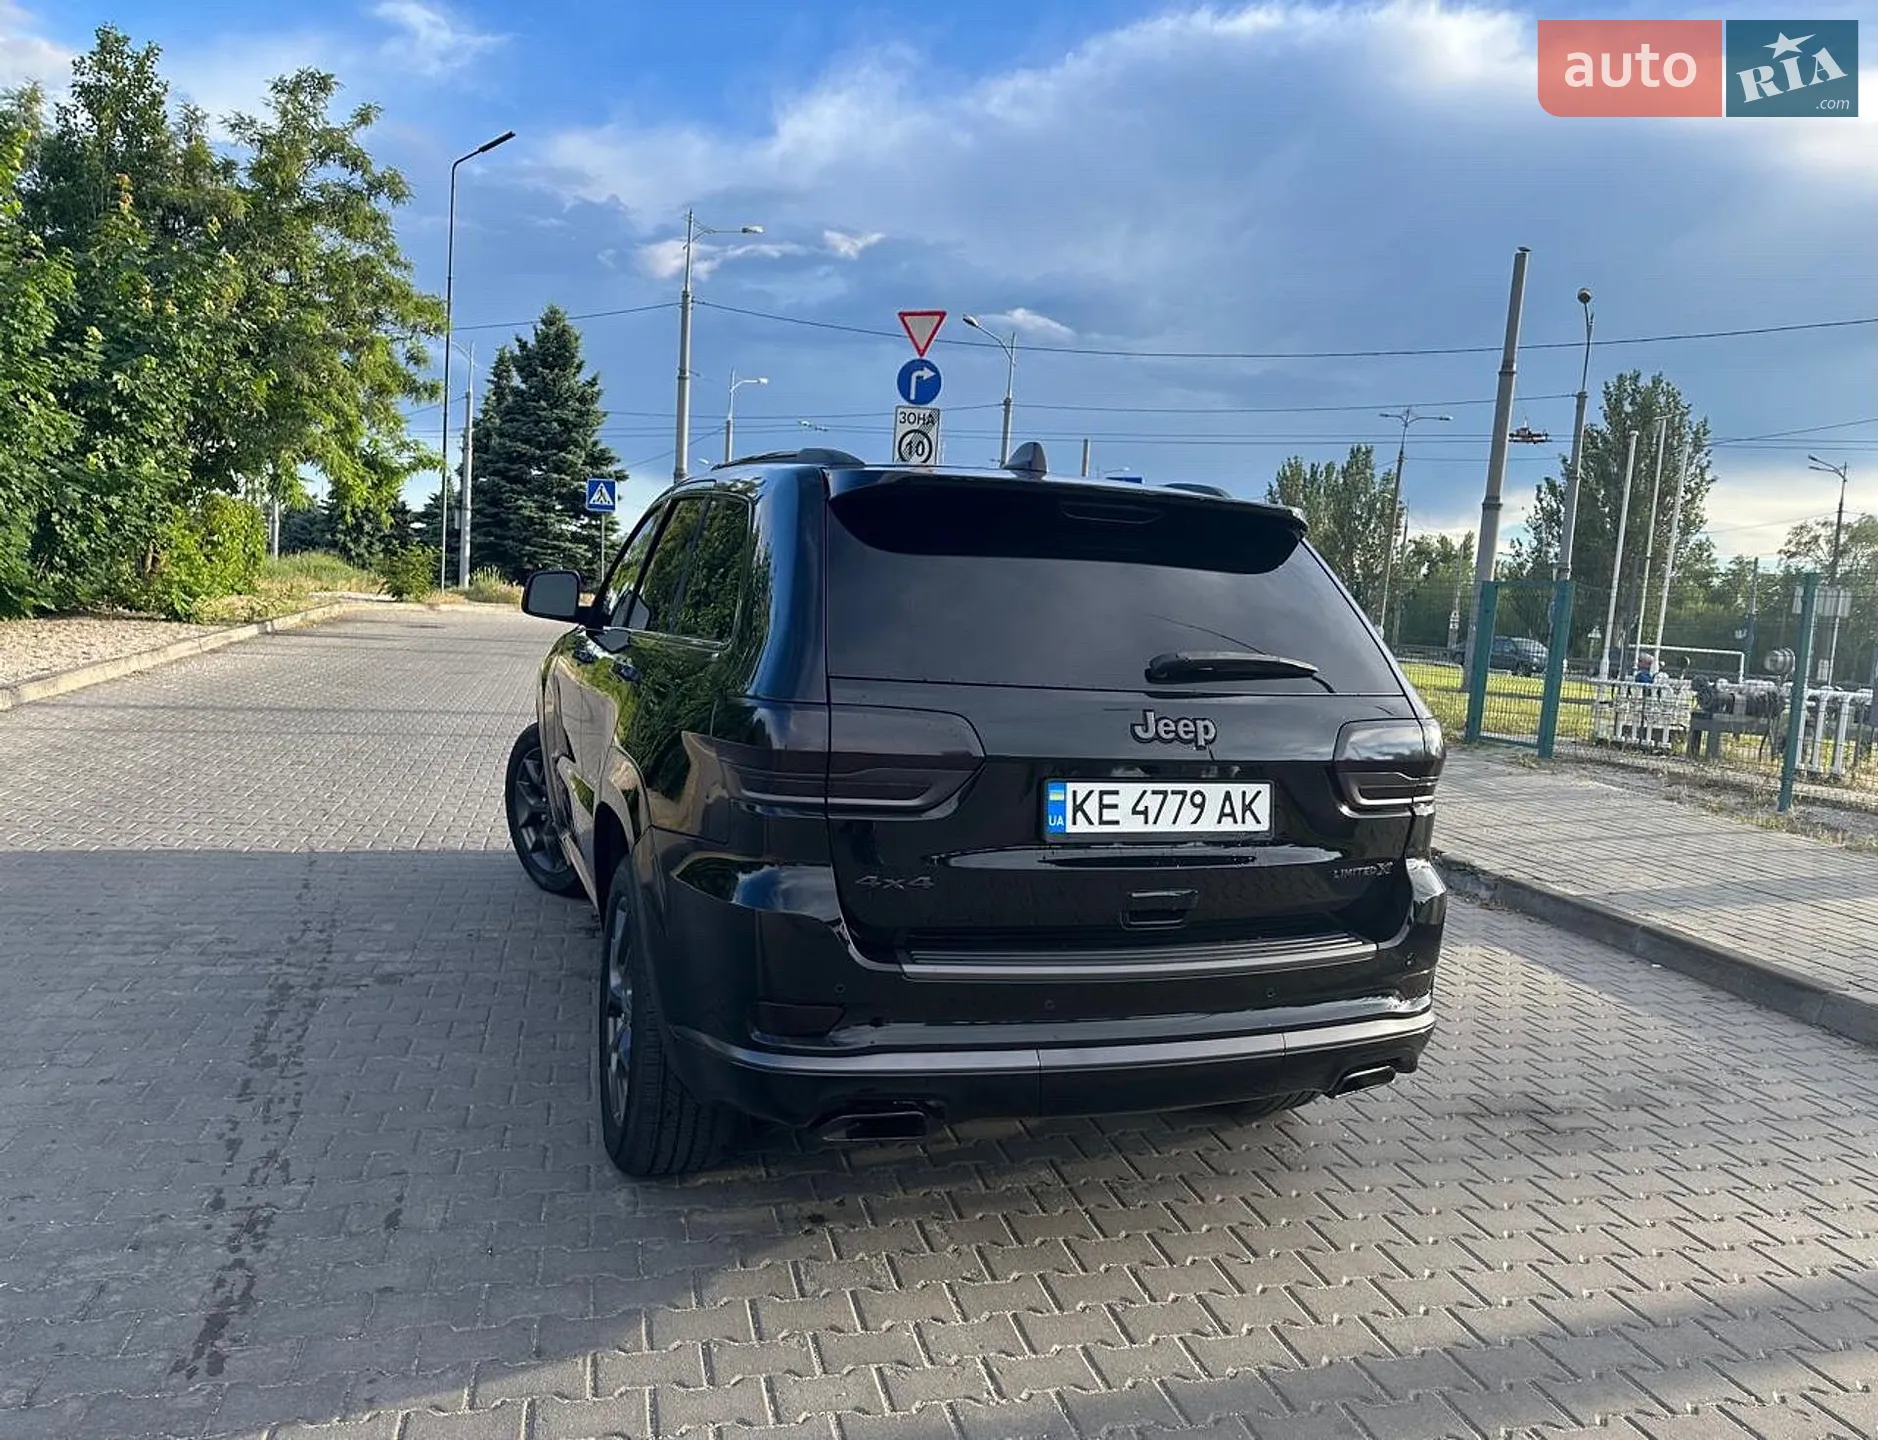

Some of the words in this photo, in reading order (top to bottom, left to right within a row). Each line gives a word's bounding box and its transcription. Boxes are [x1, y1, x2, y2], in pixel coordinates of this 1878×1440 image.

[899, 411, 935, 426] ЗОНА
[1131, 709, 1217, 749] Jeep
[1048, 815, 1065, 826] UA
[1071, 789, 1120, 826] KE
[1131, 789, 1206, 825] 4779
[1217, 789, 1262, 825] AK
